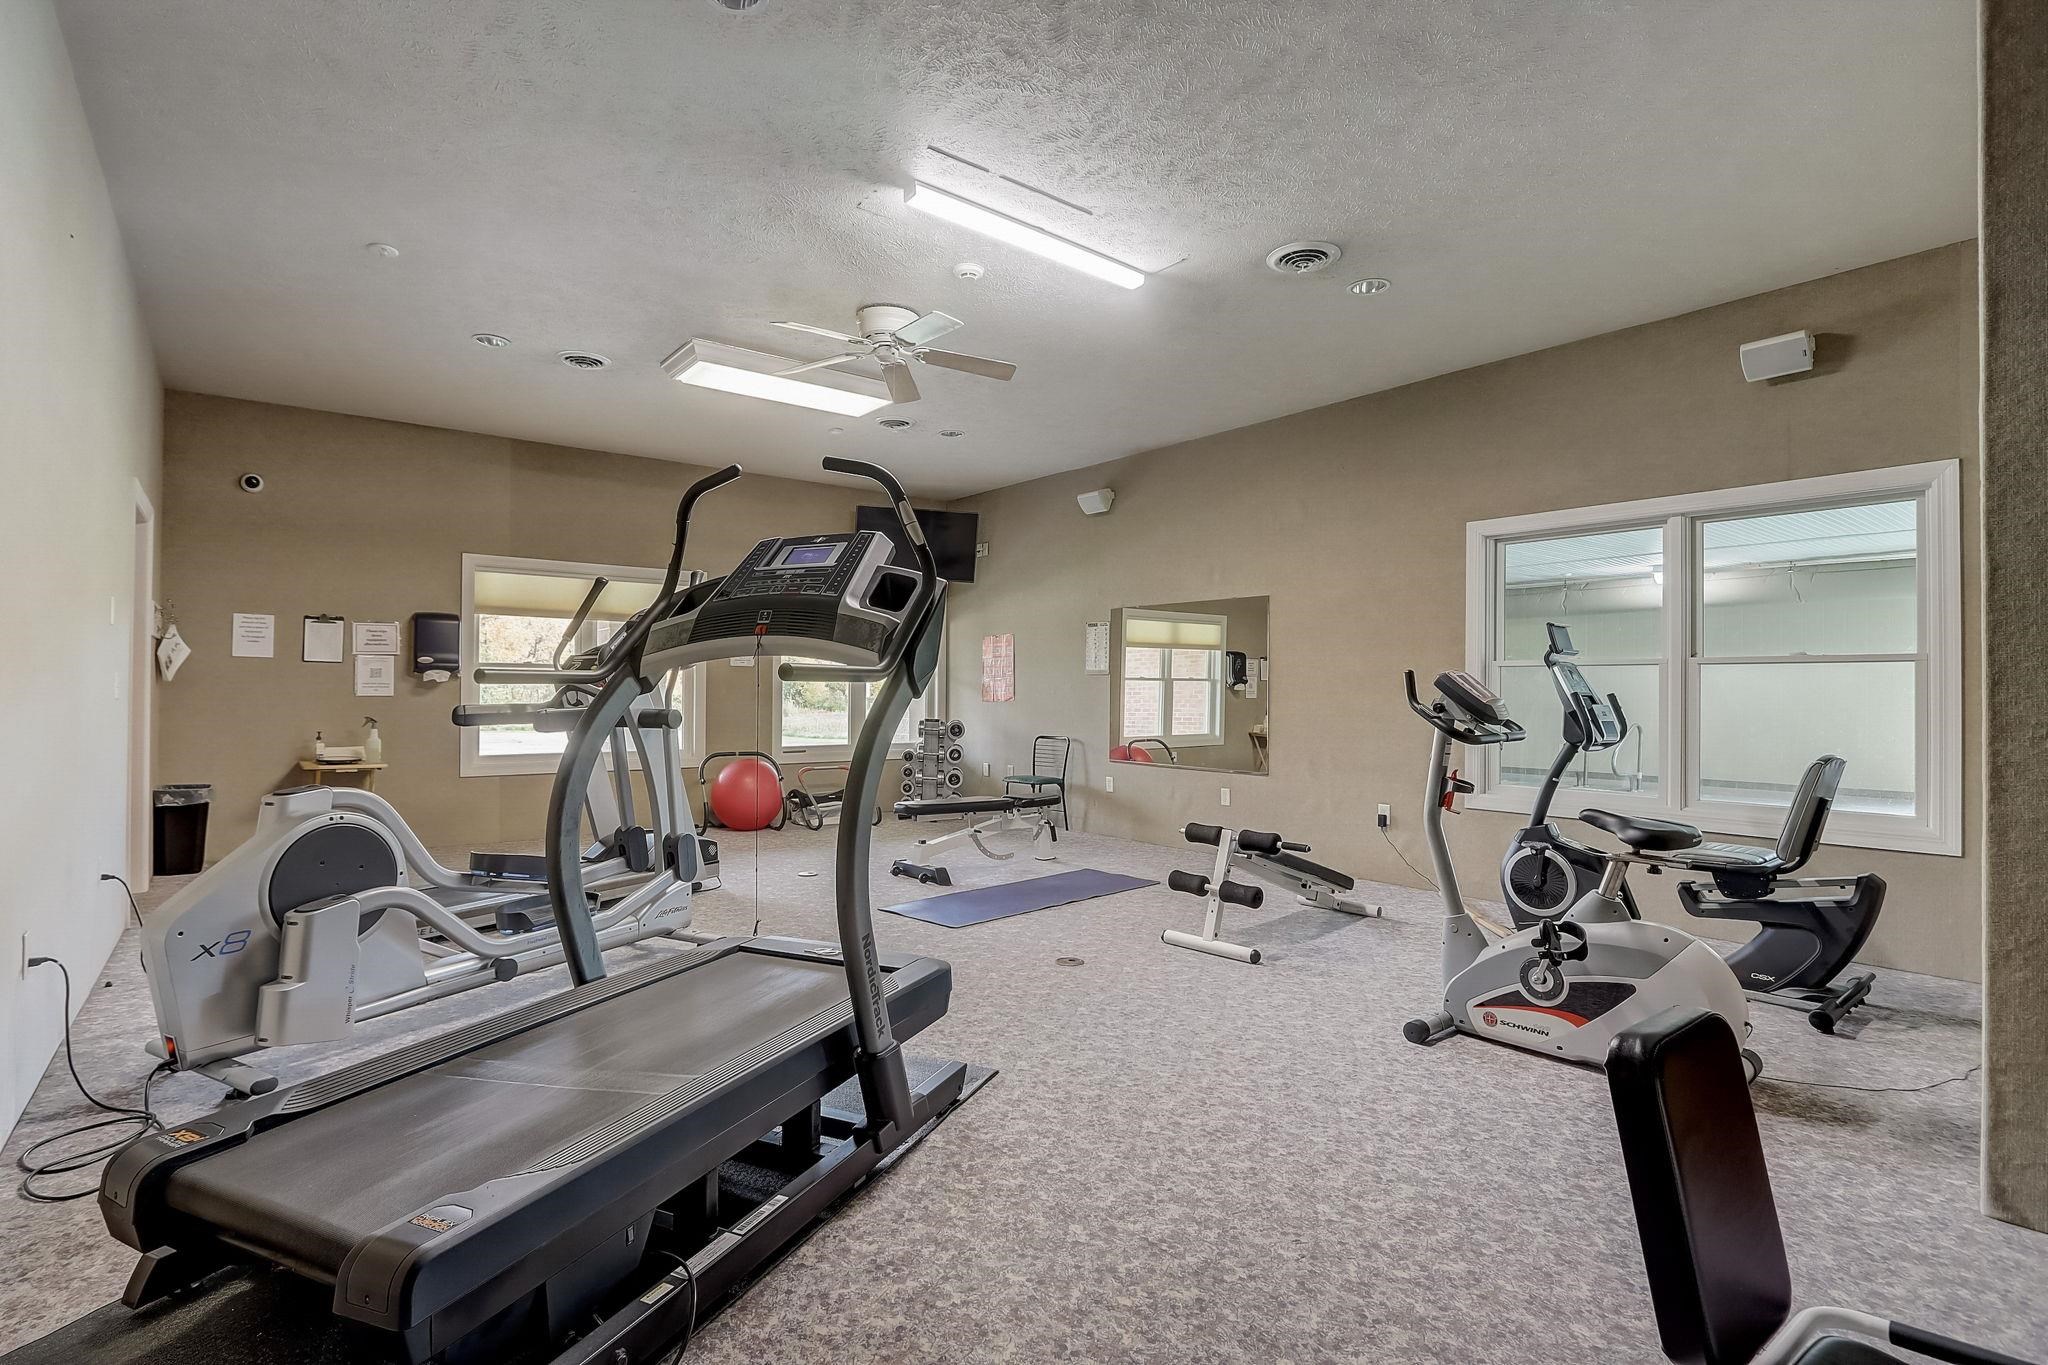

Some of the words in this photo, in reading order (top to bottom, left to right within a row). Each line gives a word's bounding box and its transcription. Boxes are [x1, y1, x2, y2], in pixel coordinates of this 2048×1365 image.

[861, 932, 886, 1039] NordicTrack
[345, 996, 353, 1024] Whisper
[1499, 1020, 1550, 1037] SCHWINN
